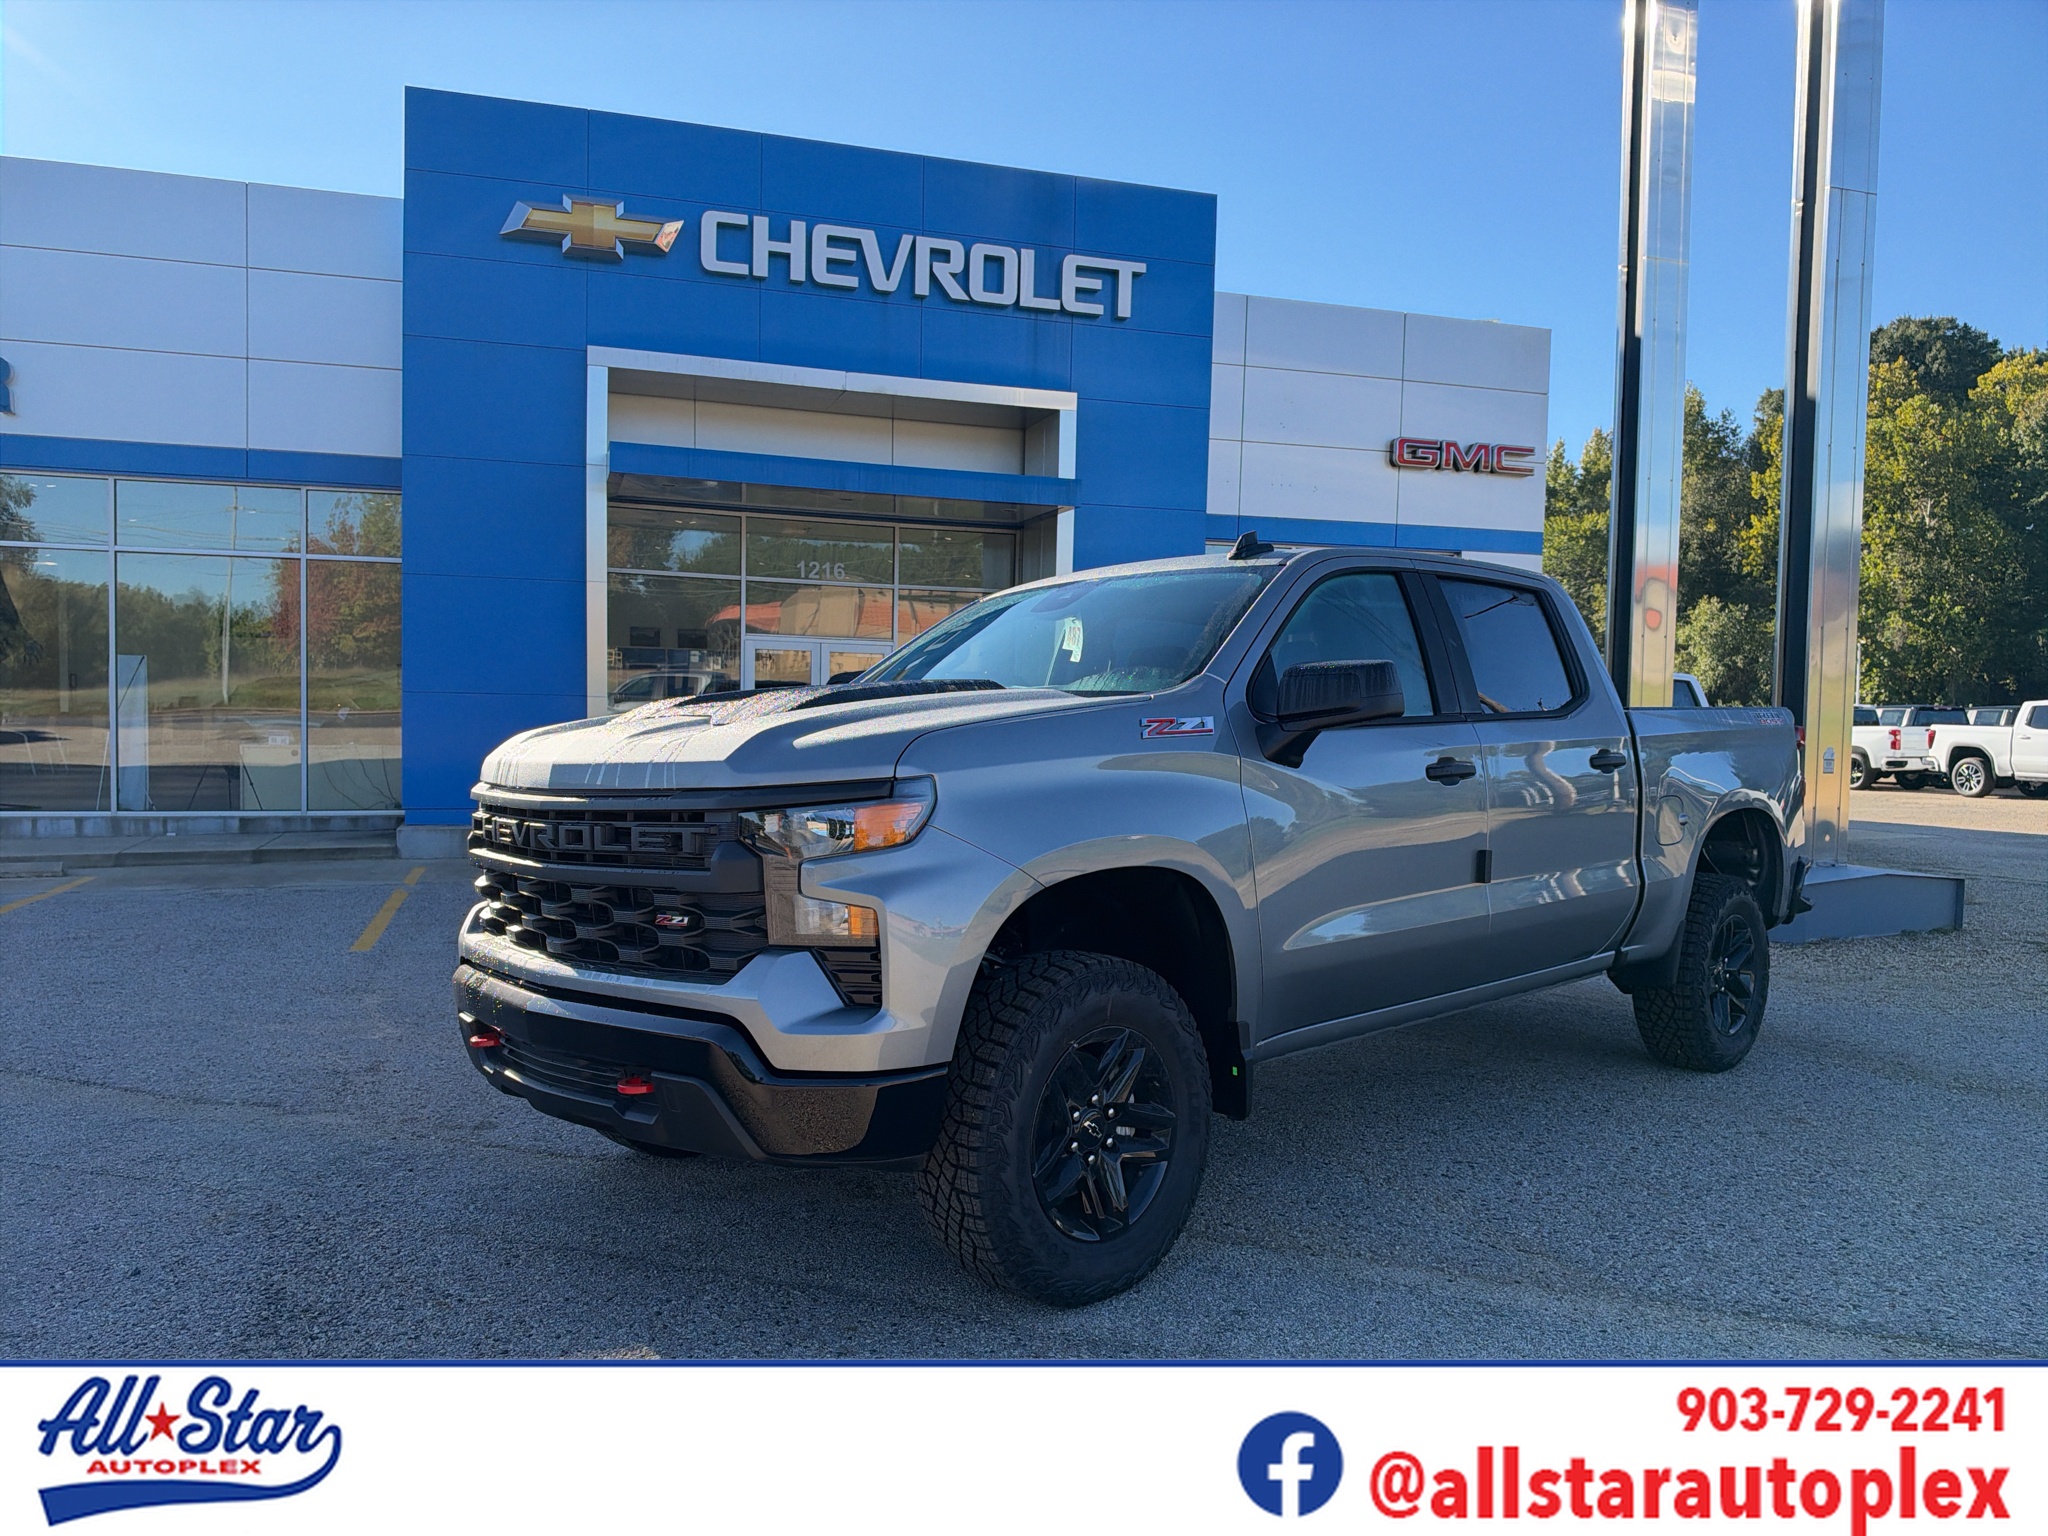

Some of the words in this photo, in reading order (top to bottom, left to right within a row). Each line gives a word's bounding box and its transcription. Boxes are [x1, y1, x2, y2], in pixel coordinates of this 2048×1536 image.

[700, 209, 1147, 319] CHEVROLET
[1390, 437, 1535, 475] GMC
[796, 560, 846, 580] 1216
[1140, 716, 1214, 739] Z71
[471, 810, 718, 855] CHEVROLET
[655, 914, 690, 926] Z71
